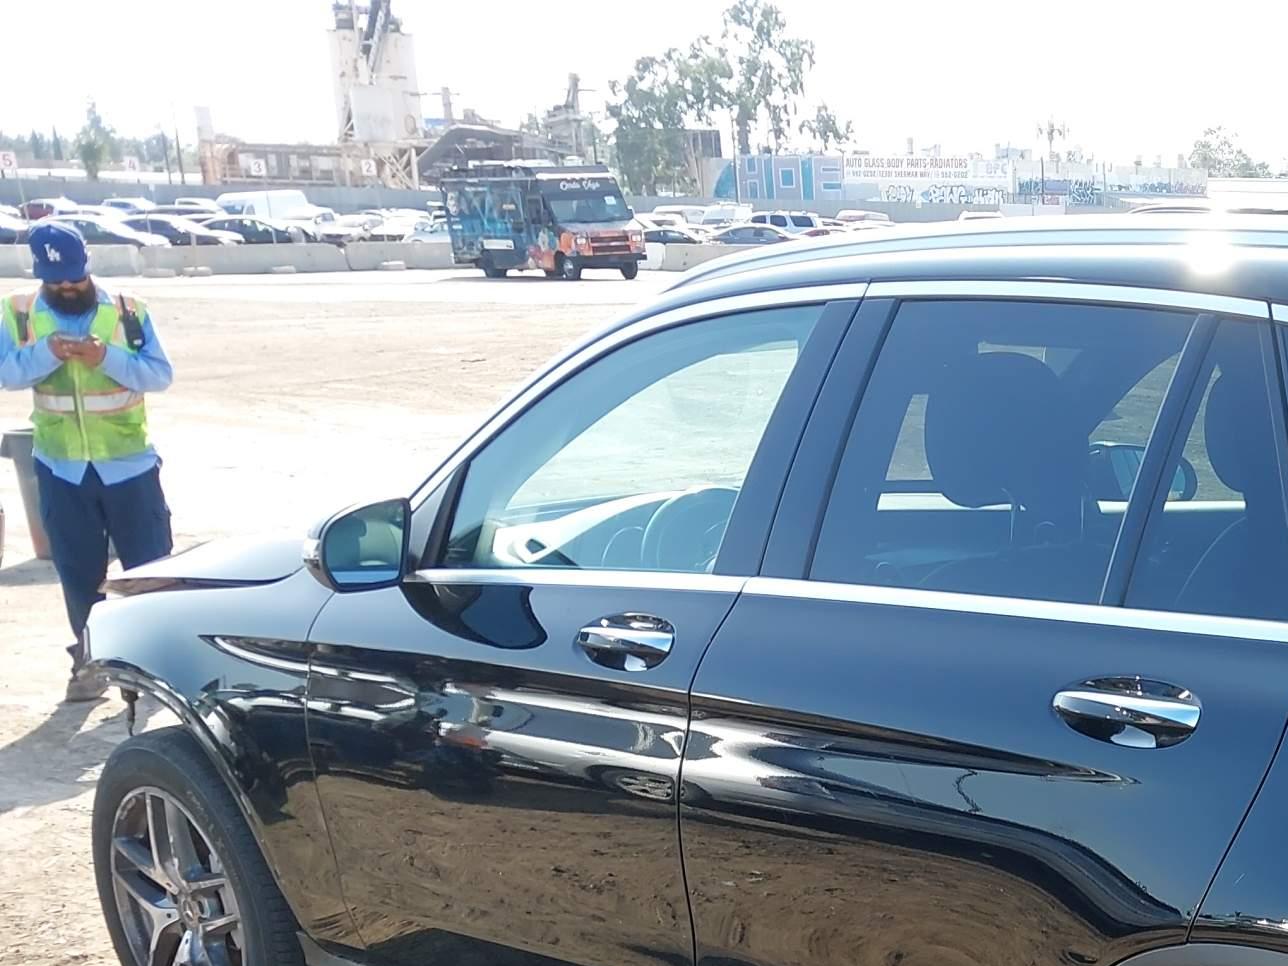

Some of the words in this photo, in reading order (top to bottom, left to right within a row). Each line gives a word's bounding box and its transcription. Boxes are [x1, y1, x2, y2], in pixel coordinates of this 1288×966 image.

[2, 153, 13, 167] 5
[253, 160, 262, 173] 3
[364, 160, 373, 173] 2
[845, 157, 862, 169] AUTO
[43, 243, 61, 262] LA
